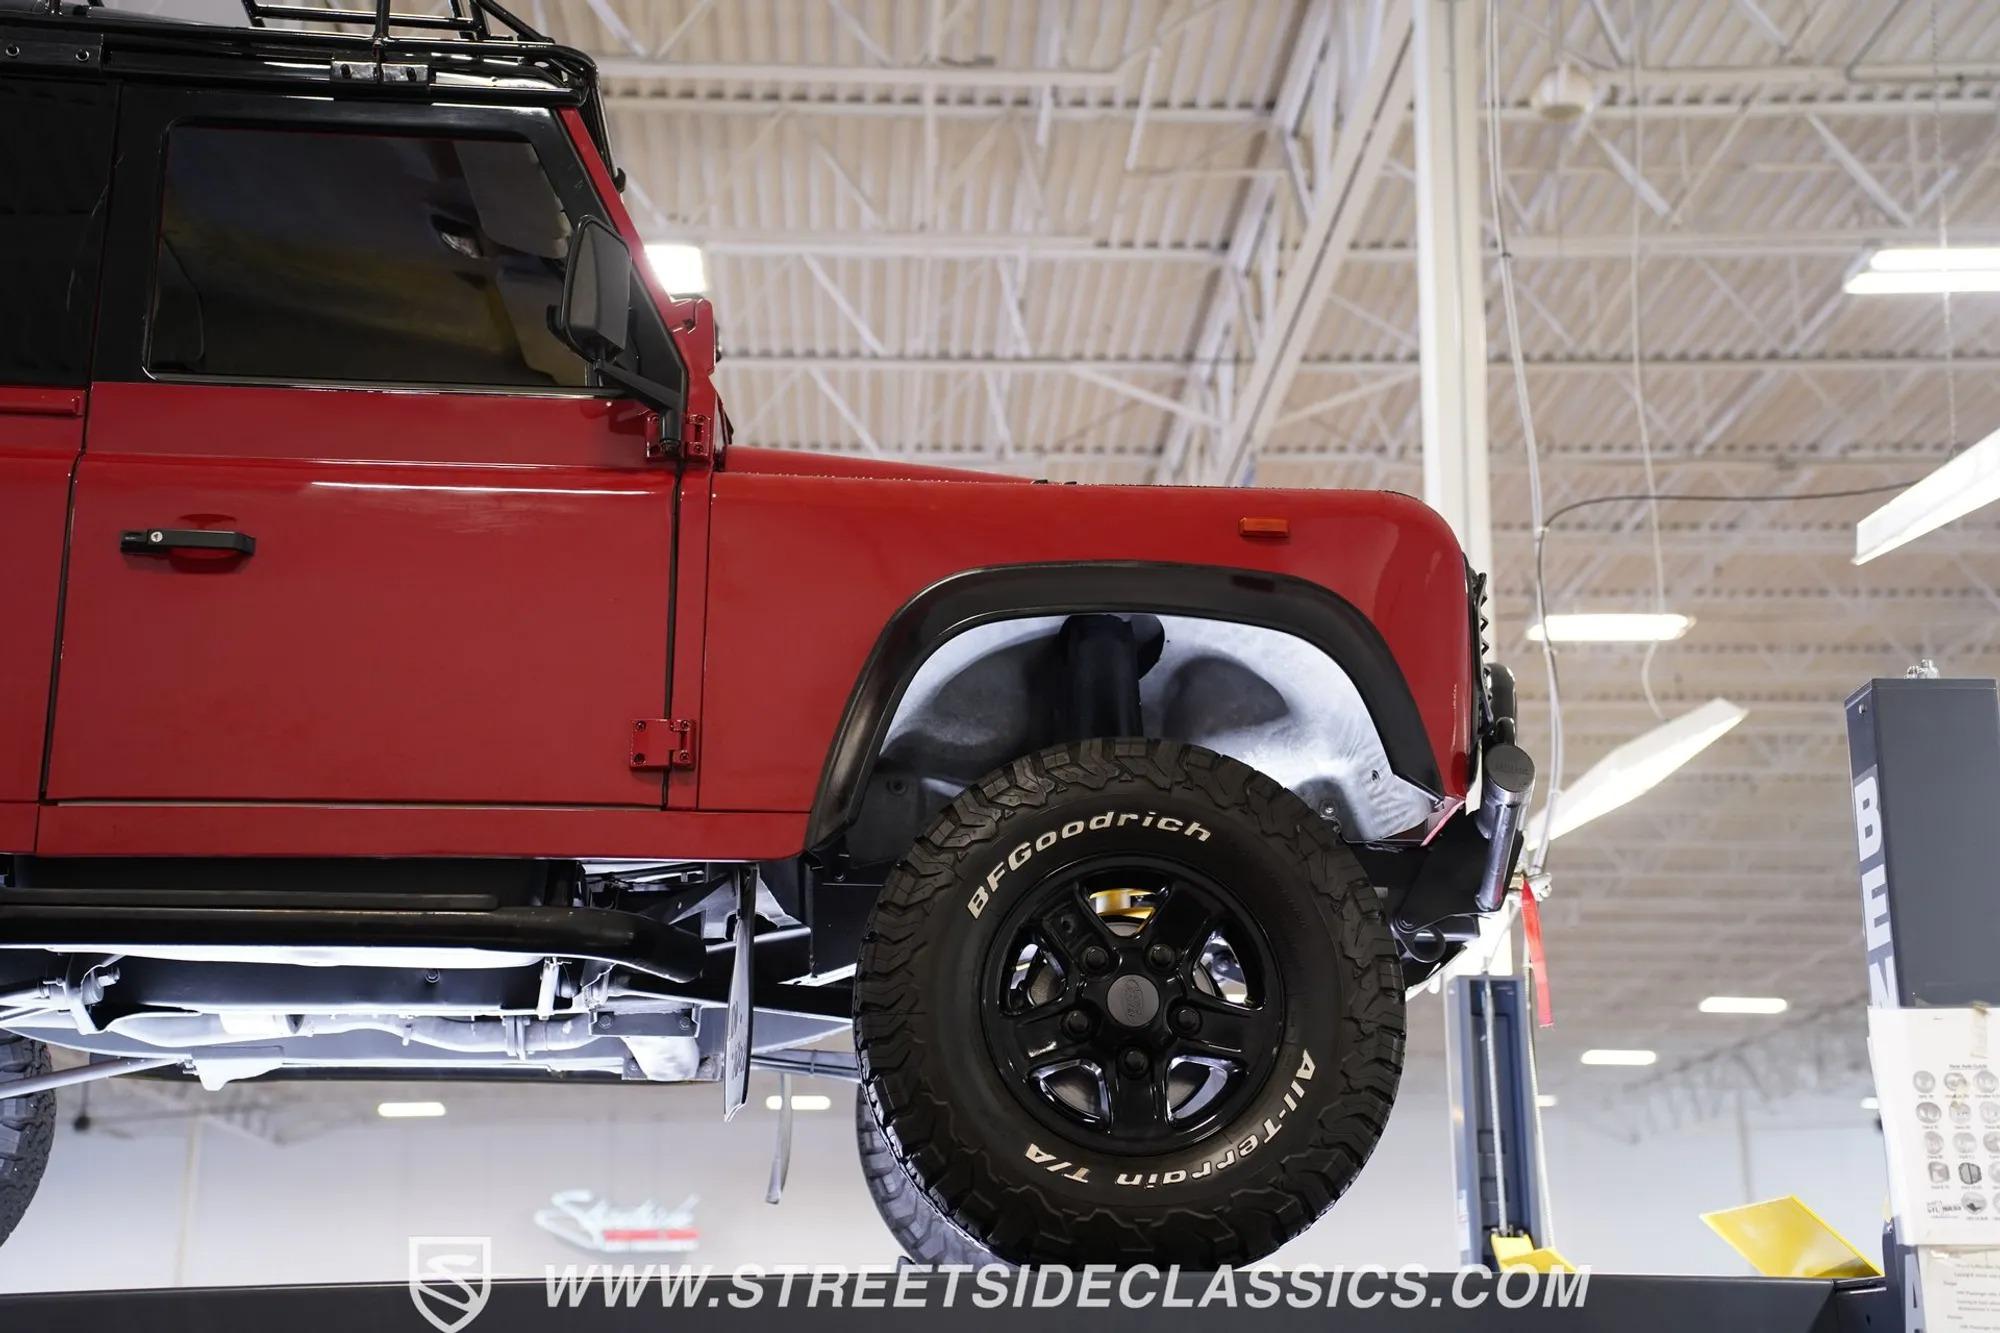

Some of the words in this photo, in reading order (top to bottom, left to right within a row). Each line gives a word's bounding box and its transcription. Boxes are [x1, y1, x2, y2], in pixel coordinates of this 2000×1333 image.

[967, 810, 1212, 920] BFGoodrich
[1024, 1142, 1091, 1186] T/A
[1115, 1048, 1317, 1190] All-Terrain
